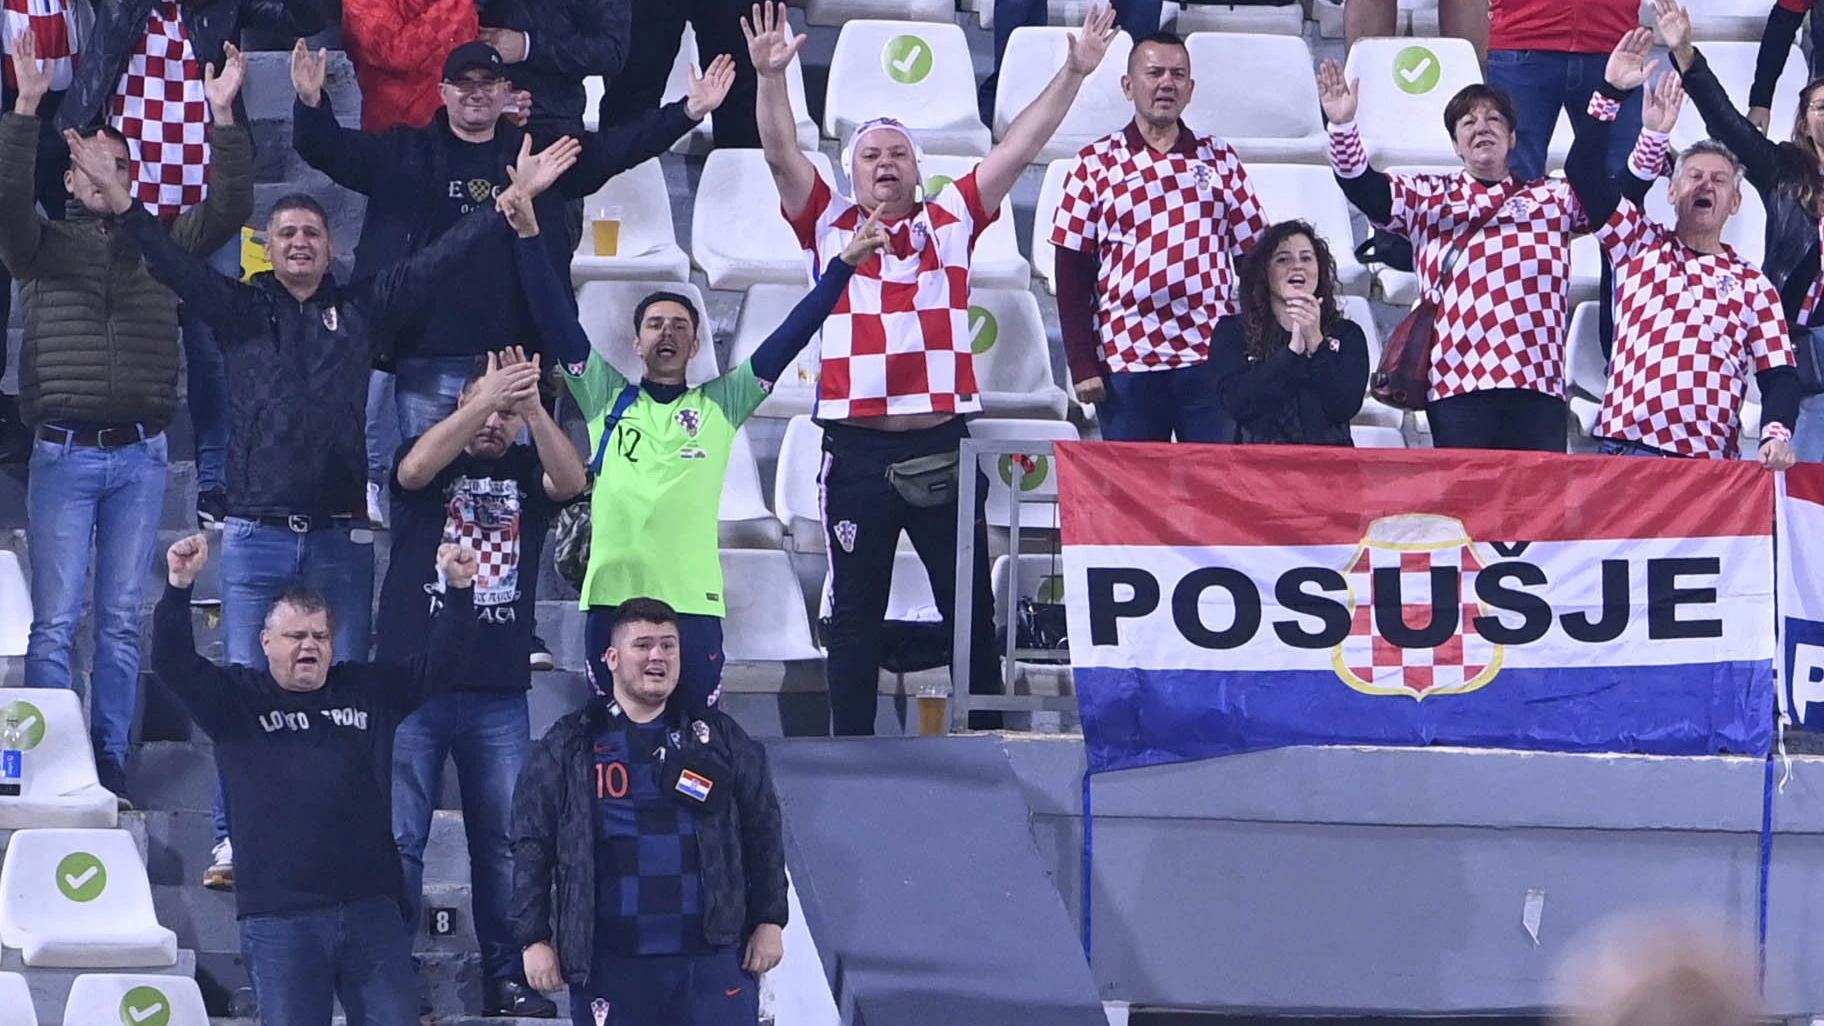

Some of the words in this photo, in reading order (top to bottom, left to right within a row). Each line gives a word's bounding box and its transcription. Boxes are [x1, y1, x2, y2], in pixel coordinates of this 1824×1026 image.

[617, 424, 642, 463] 12
[1086, 540, 1724, 650] POSUŠJE
[595, 761, 629, 799] 10
[436, 911, 449, 934] 8
